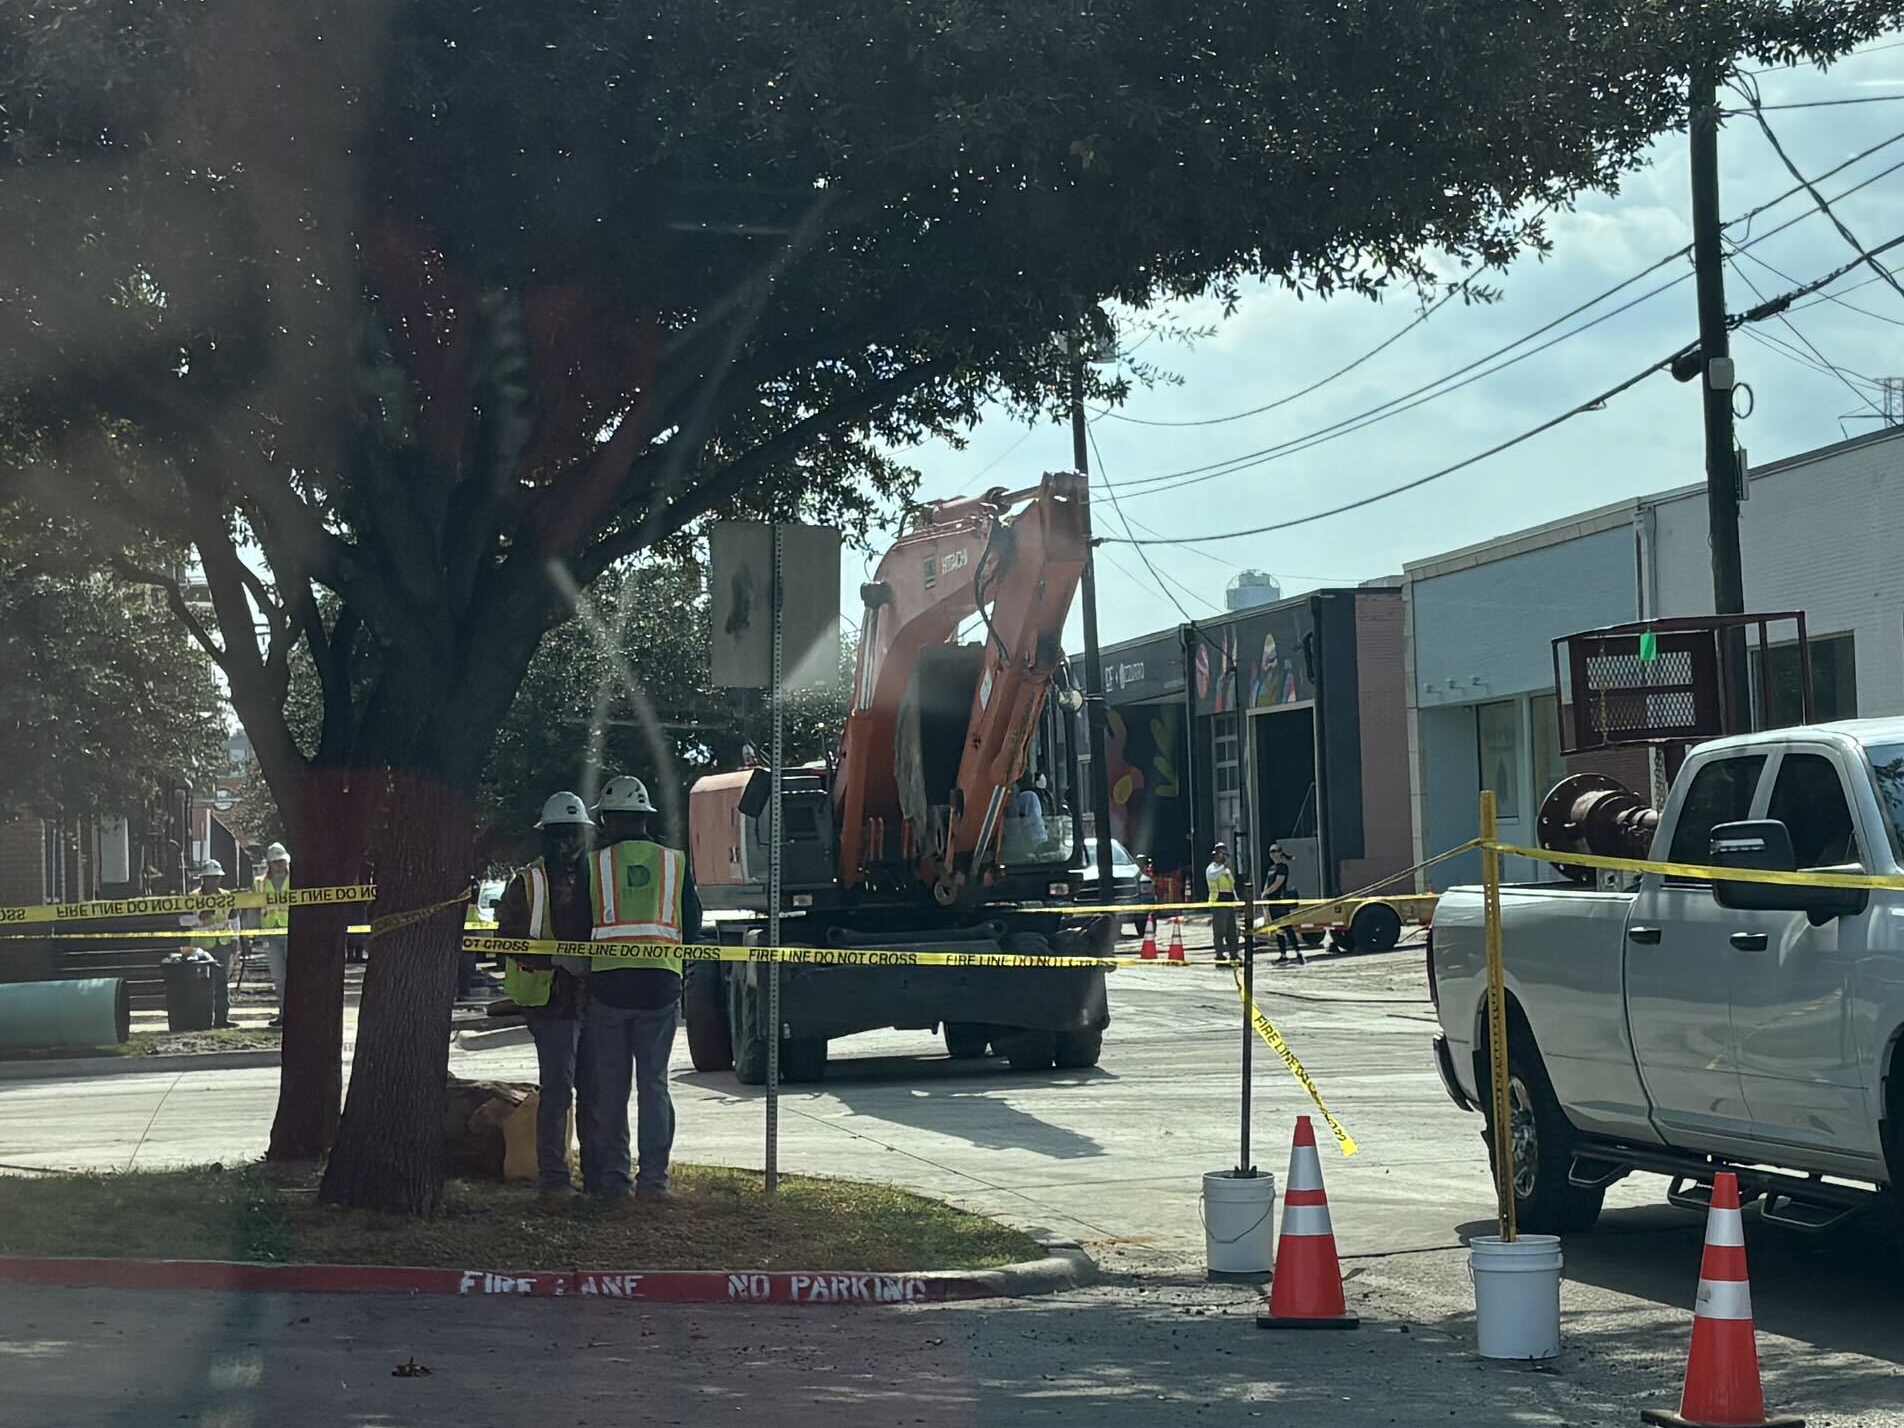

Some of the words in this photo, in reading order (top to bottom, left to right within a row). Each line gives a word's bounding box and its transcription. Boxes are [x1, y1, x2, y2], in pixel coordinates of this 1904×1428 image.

[463, 938, 482, 948] OT
[483, 939, 530, 951] CROSS
[556, 942, 586, 954] FIRE
[589, 943, 617, 956] LINE
[620, 944, 640, 956] DO
[644, 945, 670, 957] NOT
[674, 946, 721, 959] CROSS
[748, 948, 779, 958] FIRE
[782, 949, 811, 962] LINE
[814, 951, 834, 963] DO
[838, 952, 865, 964] NOT
[868, 952, 917, 965] CROSS
[946, 955, 975, 966] FIRE
[1255, 1013, 1280, 1043] FIRE
[460, 1270, 537, 1295] FIRE
[729, 1274, 770, 1299] NO
[791, 1275, 926, 1302] PARKING
